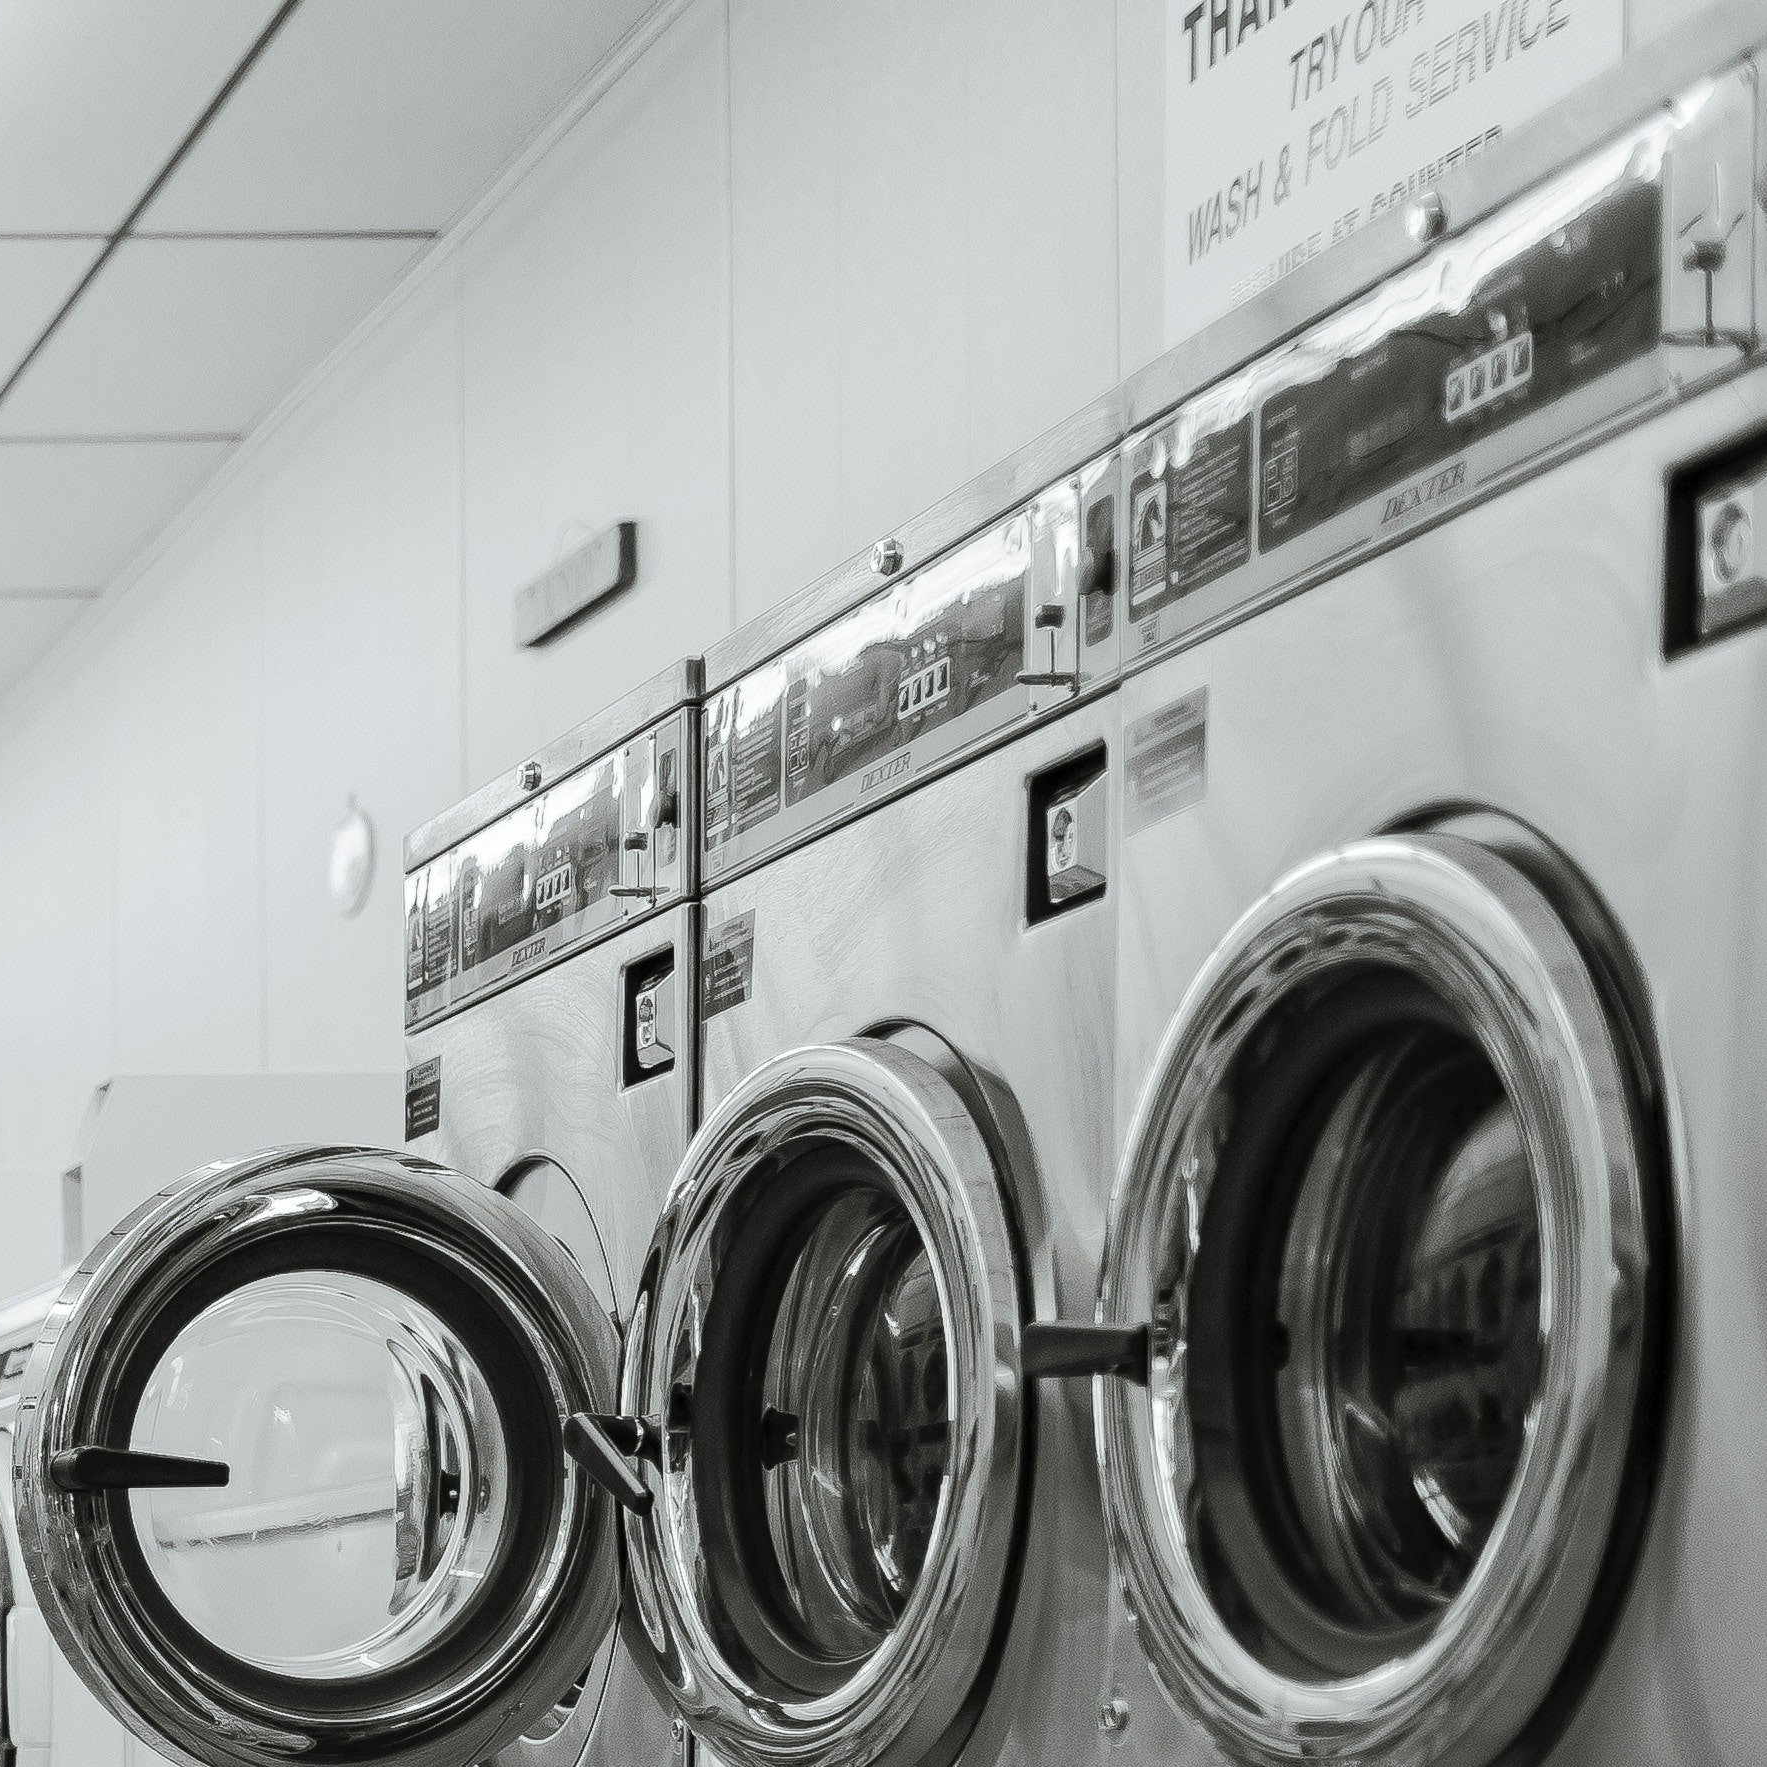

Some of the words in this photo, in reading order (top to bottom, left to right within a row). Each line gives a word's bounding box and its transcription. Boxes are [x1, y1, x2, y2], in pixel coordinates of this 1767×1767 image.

[1183, 0, 1294, 84] THA
[1289, 14, 1350, 111] TRY
[1188, 158, 1264, 266] WASH
[1272, 144, 1293, 206] &
[1305, 76, 1394, 186] FOLD
[1405, 0, 1572, 118] SERVICE
[1380, 460, 1467, 526] DEXTER
[860, 752, 911, 795] DEXTER
